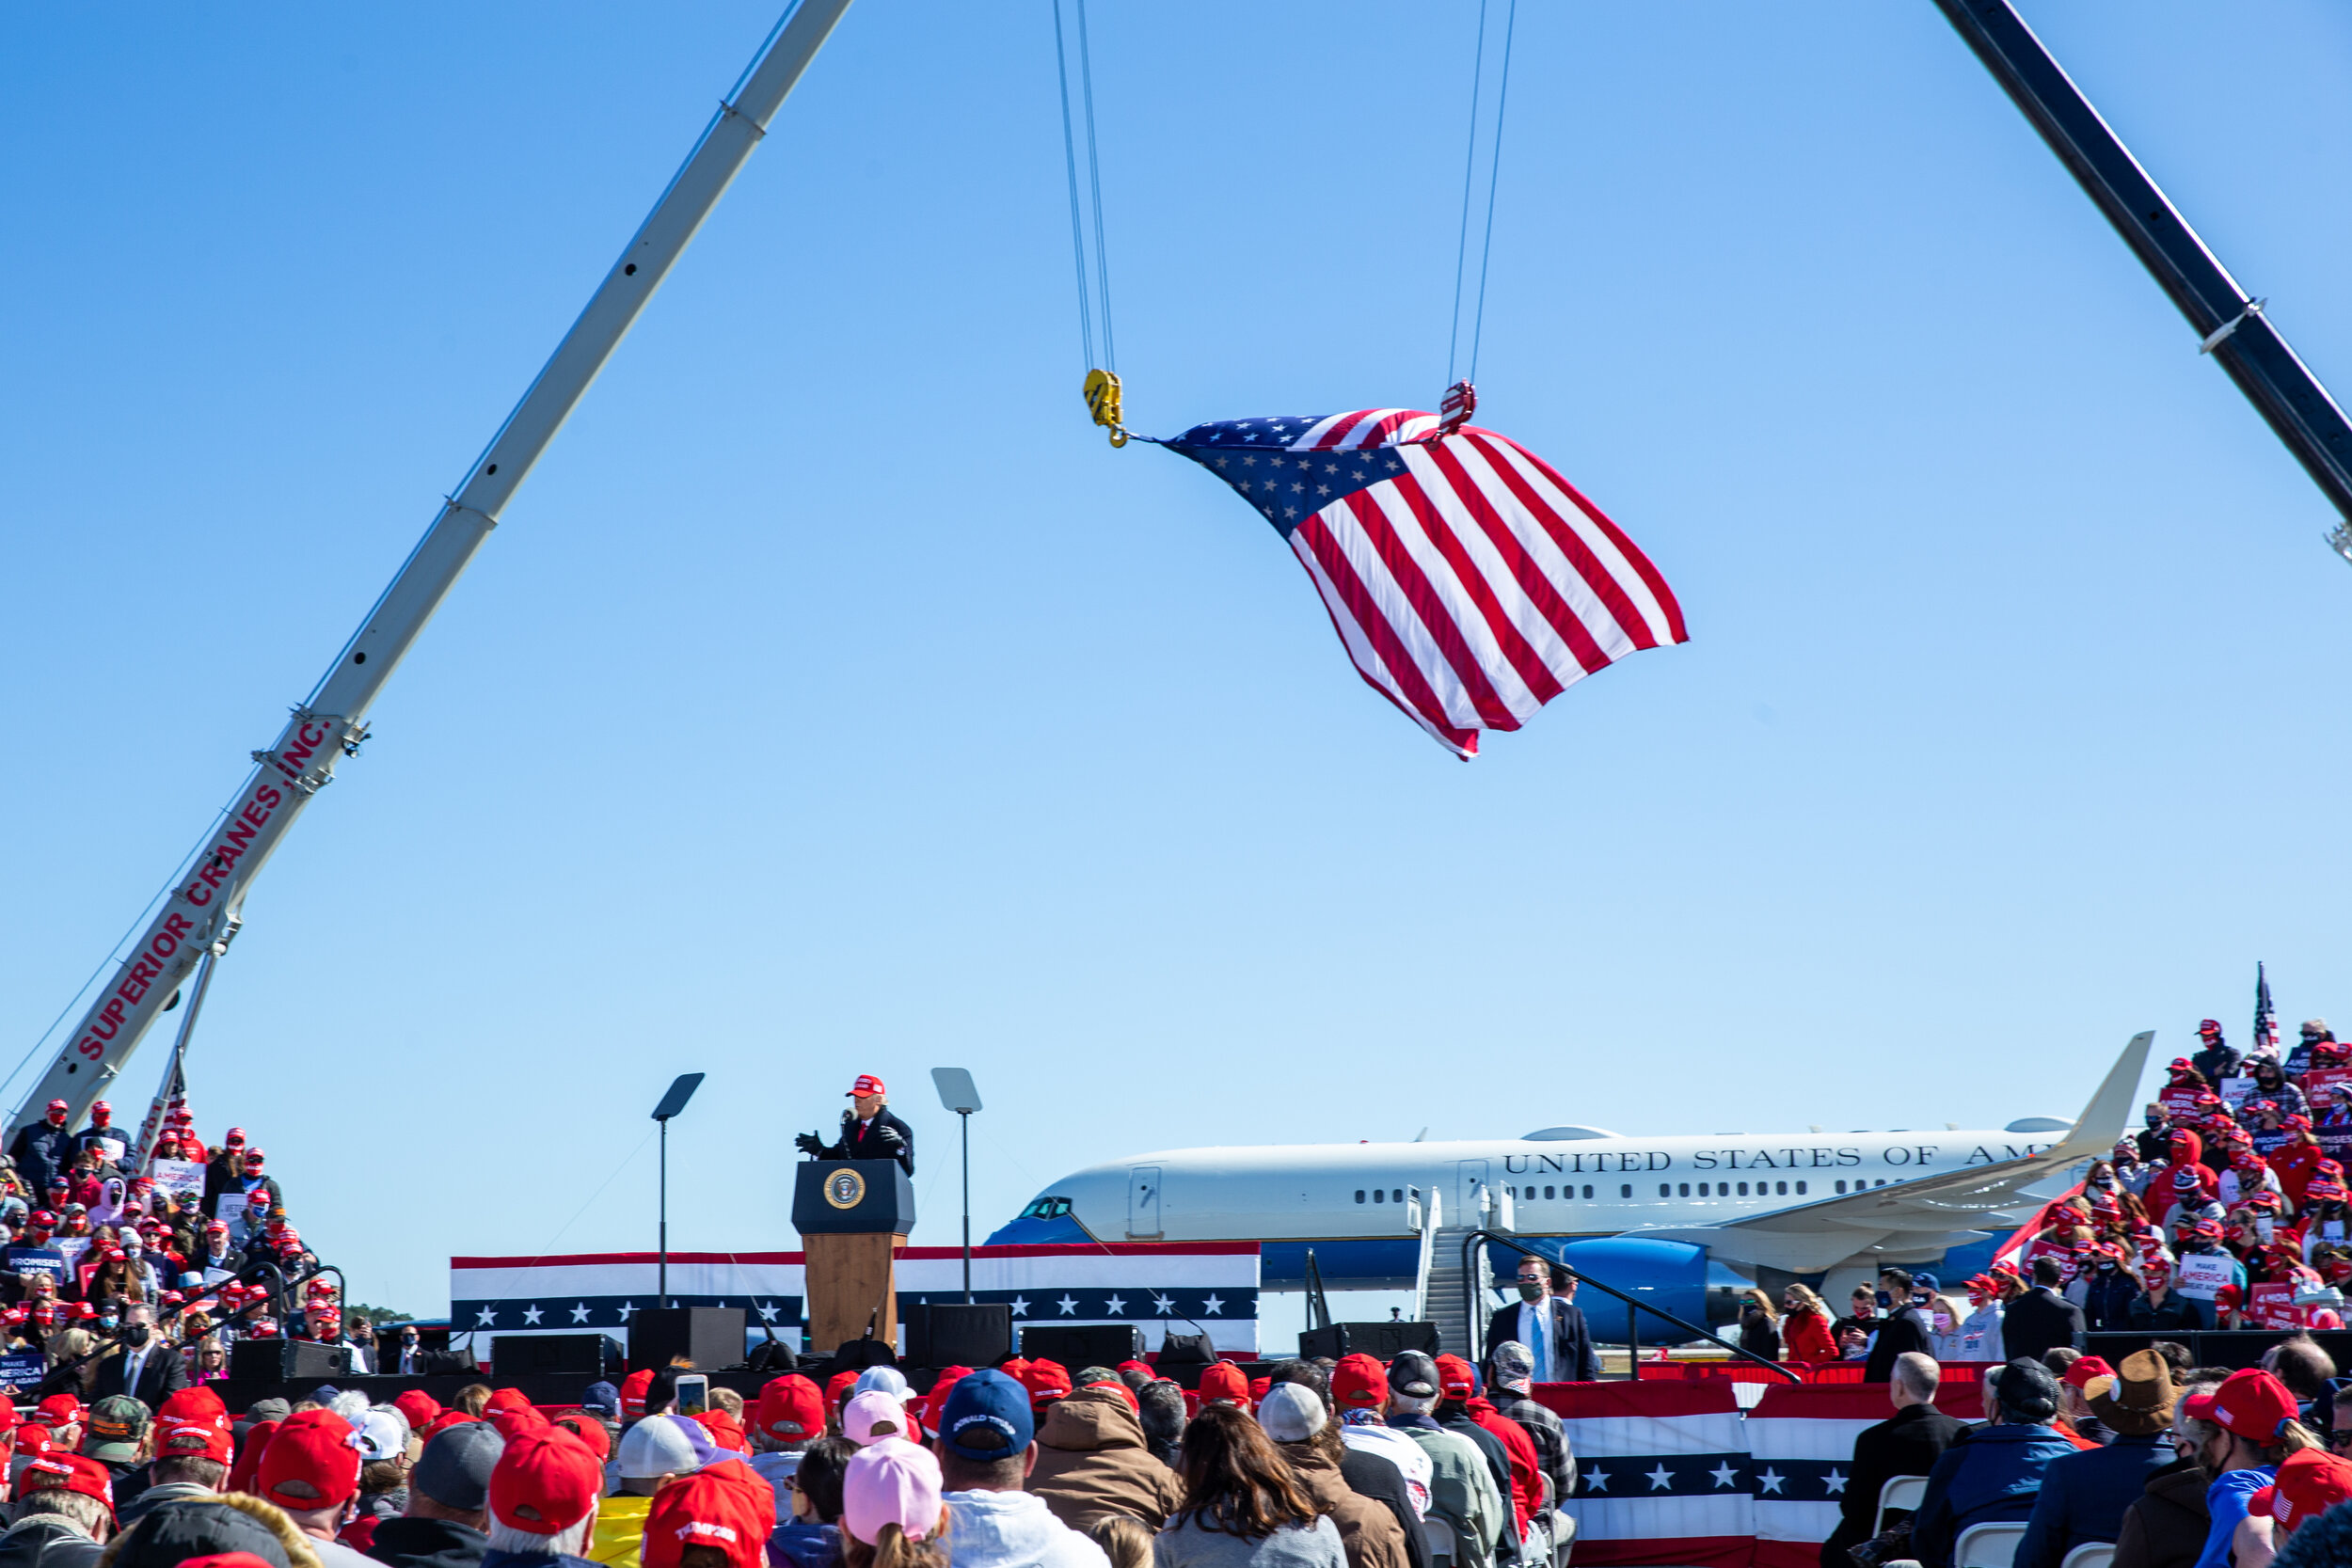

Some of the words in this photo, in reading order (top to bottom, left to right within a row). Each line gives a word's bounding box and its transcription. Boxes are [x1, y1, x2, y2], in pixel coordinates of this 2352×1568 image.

[79, 912, 194, 1061] SUPERIOR
[1502, 1151, 1672, 1174] UNITED
[1693, 1147, 1862, 1170] STATES
[1883, 1145, 1940, 1166] OF
[155, 1171, 201, 1182] AMERICA
[9, 1258, 62, 1268] PROMISES
[2195, 1262, 2217, 1271] MAKE
[2183, 1271, 2229, 1283] AMERICA
